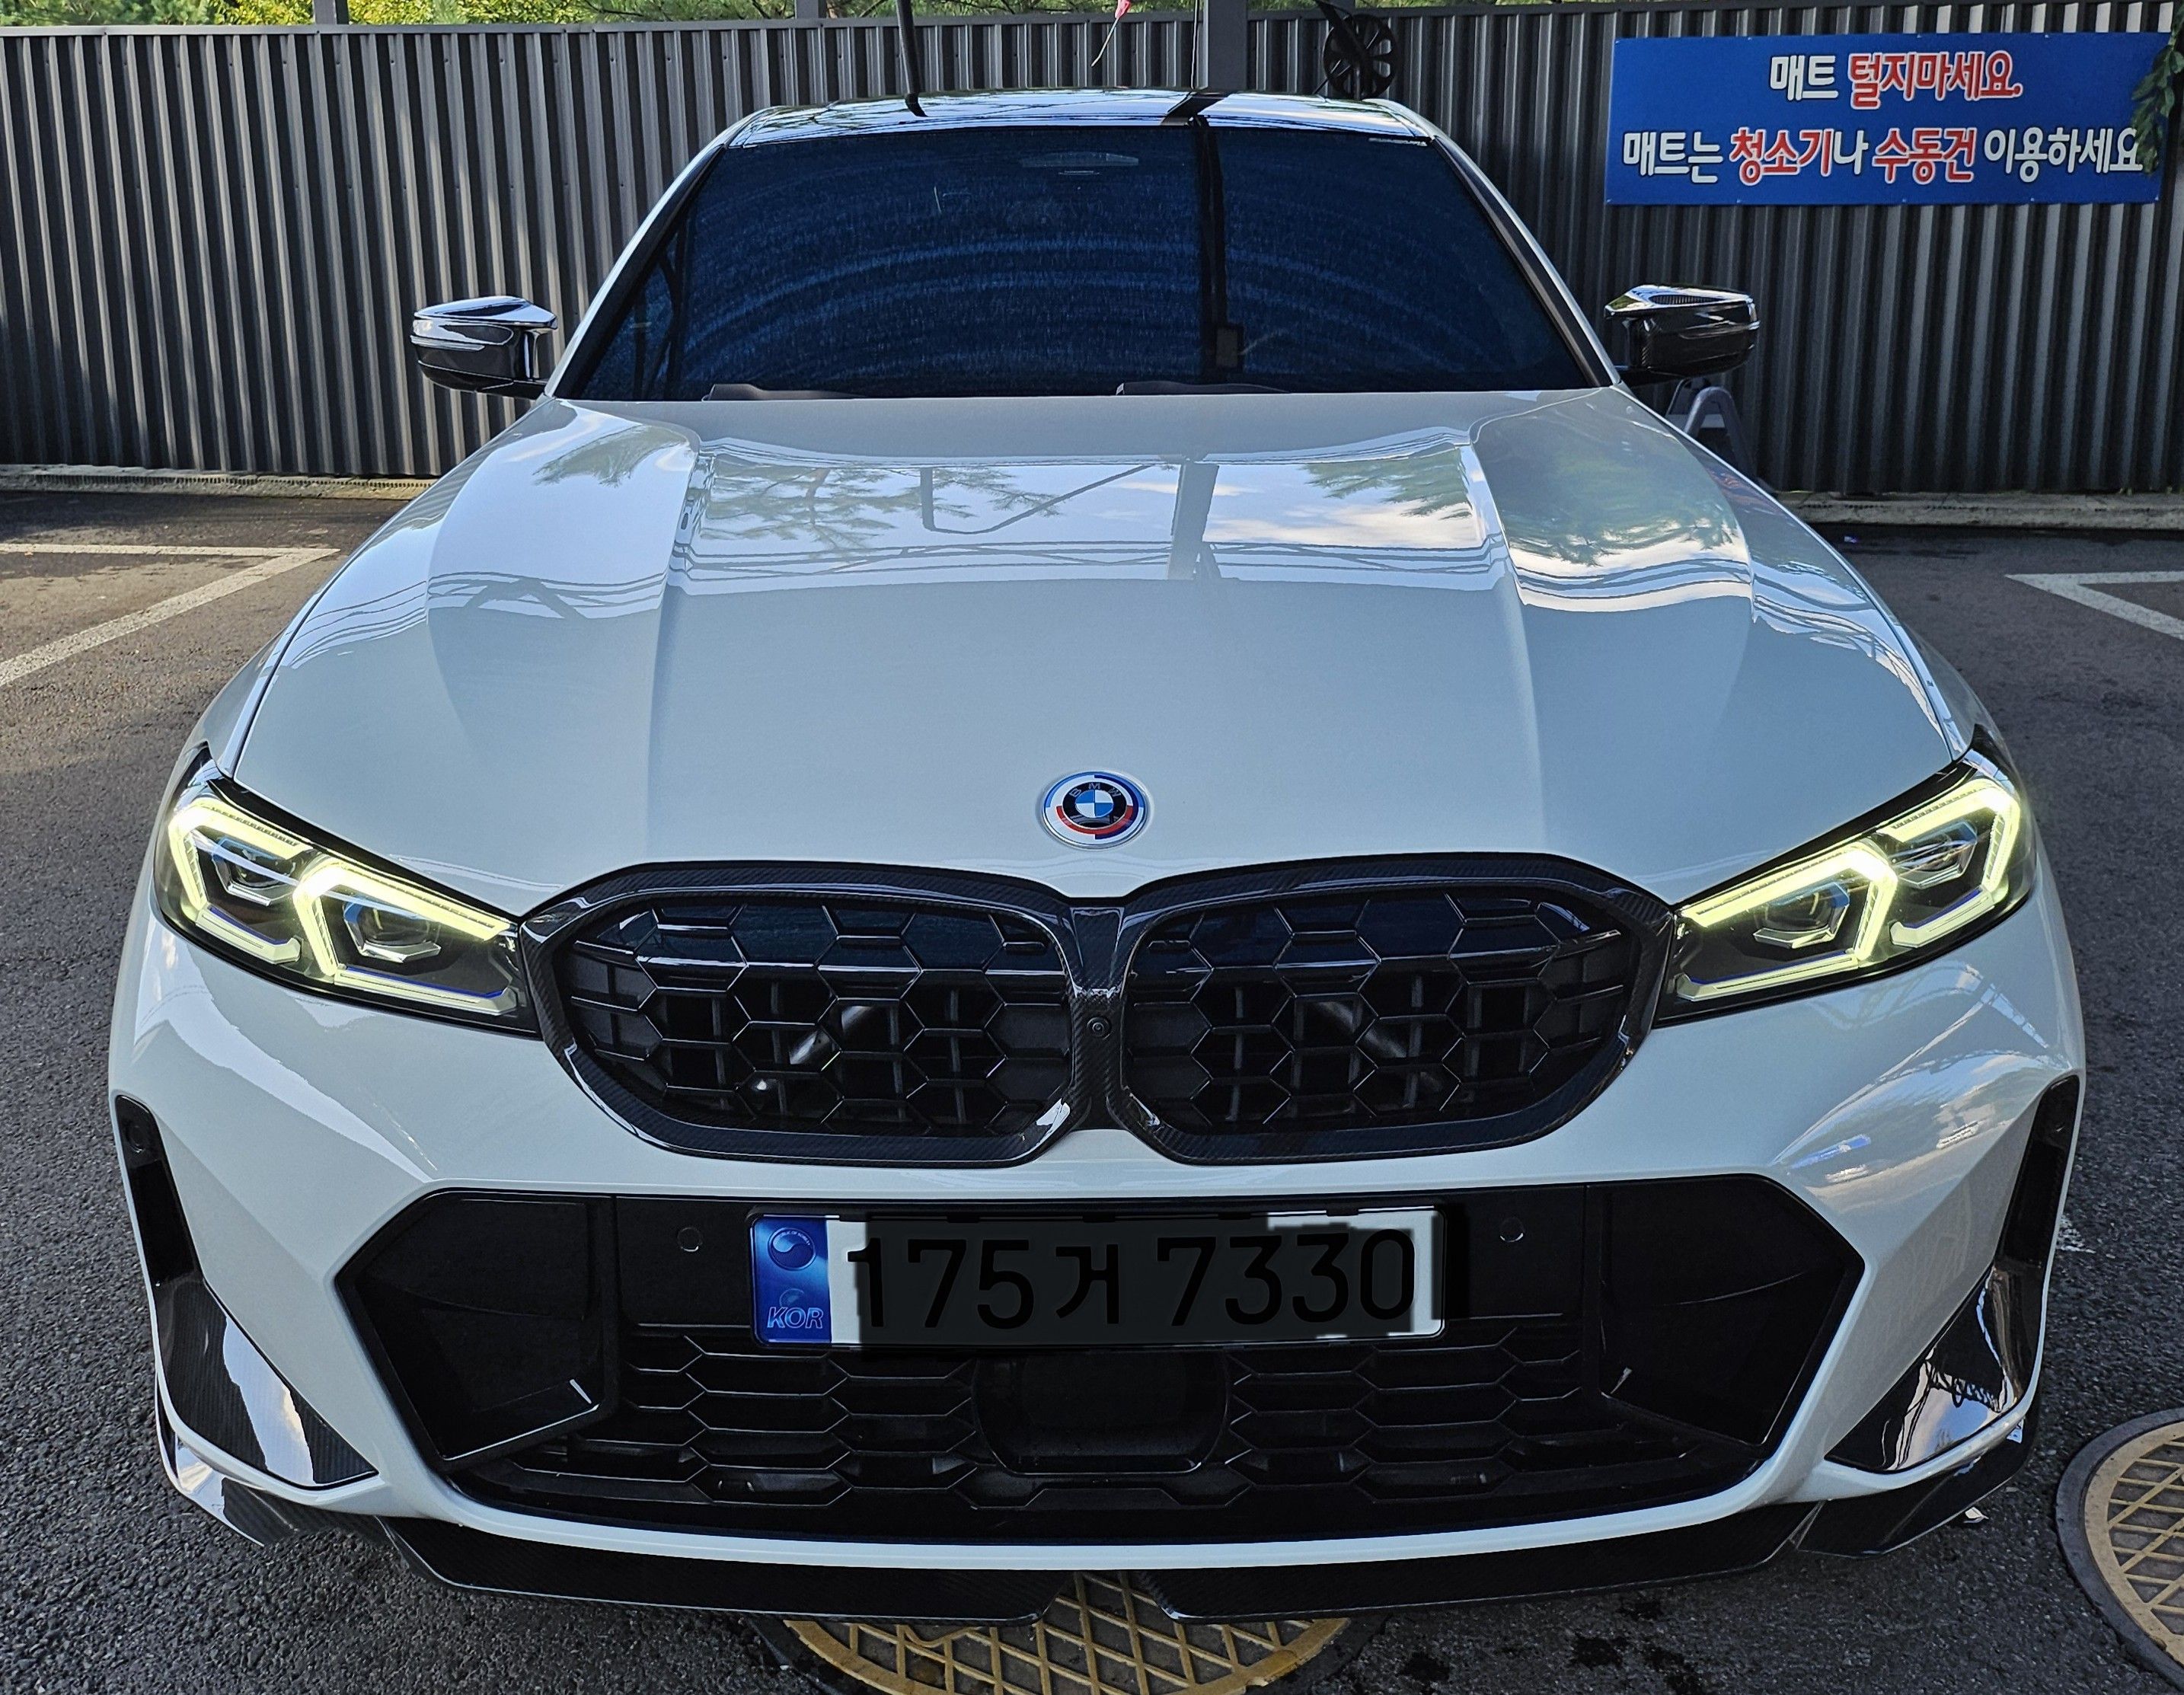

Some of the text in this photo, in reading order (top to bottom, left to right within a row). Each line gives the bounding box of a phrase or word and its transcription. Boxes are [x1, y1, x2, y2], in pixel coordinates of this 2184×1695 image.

[1770, 55, 1839, 101] 매트
[1624, 126, 2144, 186] 매트는 청소기나 수동건 이용하세요
[1068, 781, 1122, 798] BMW
[1157, 1228, 1416, 1326] 7330
[767, 1306, 824, 1330] KOR
